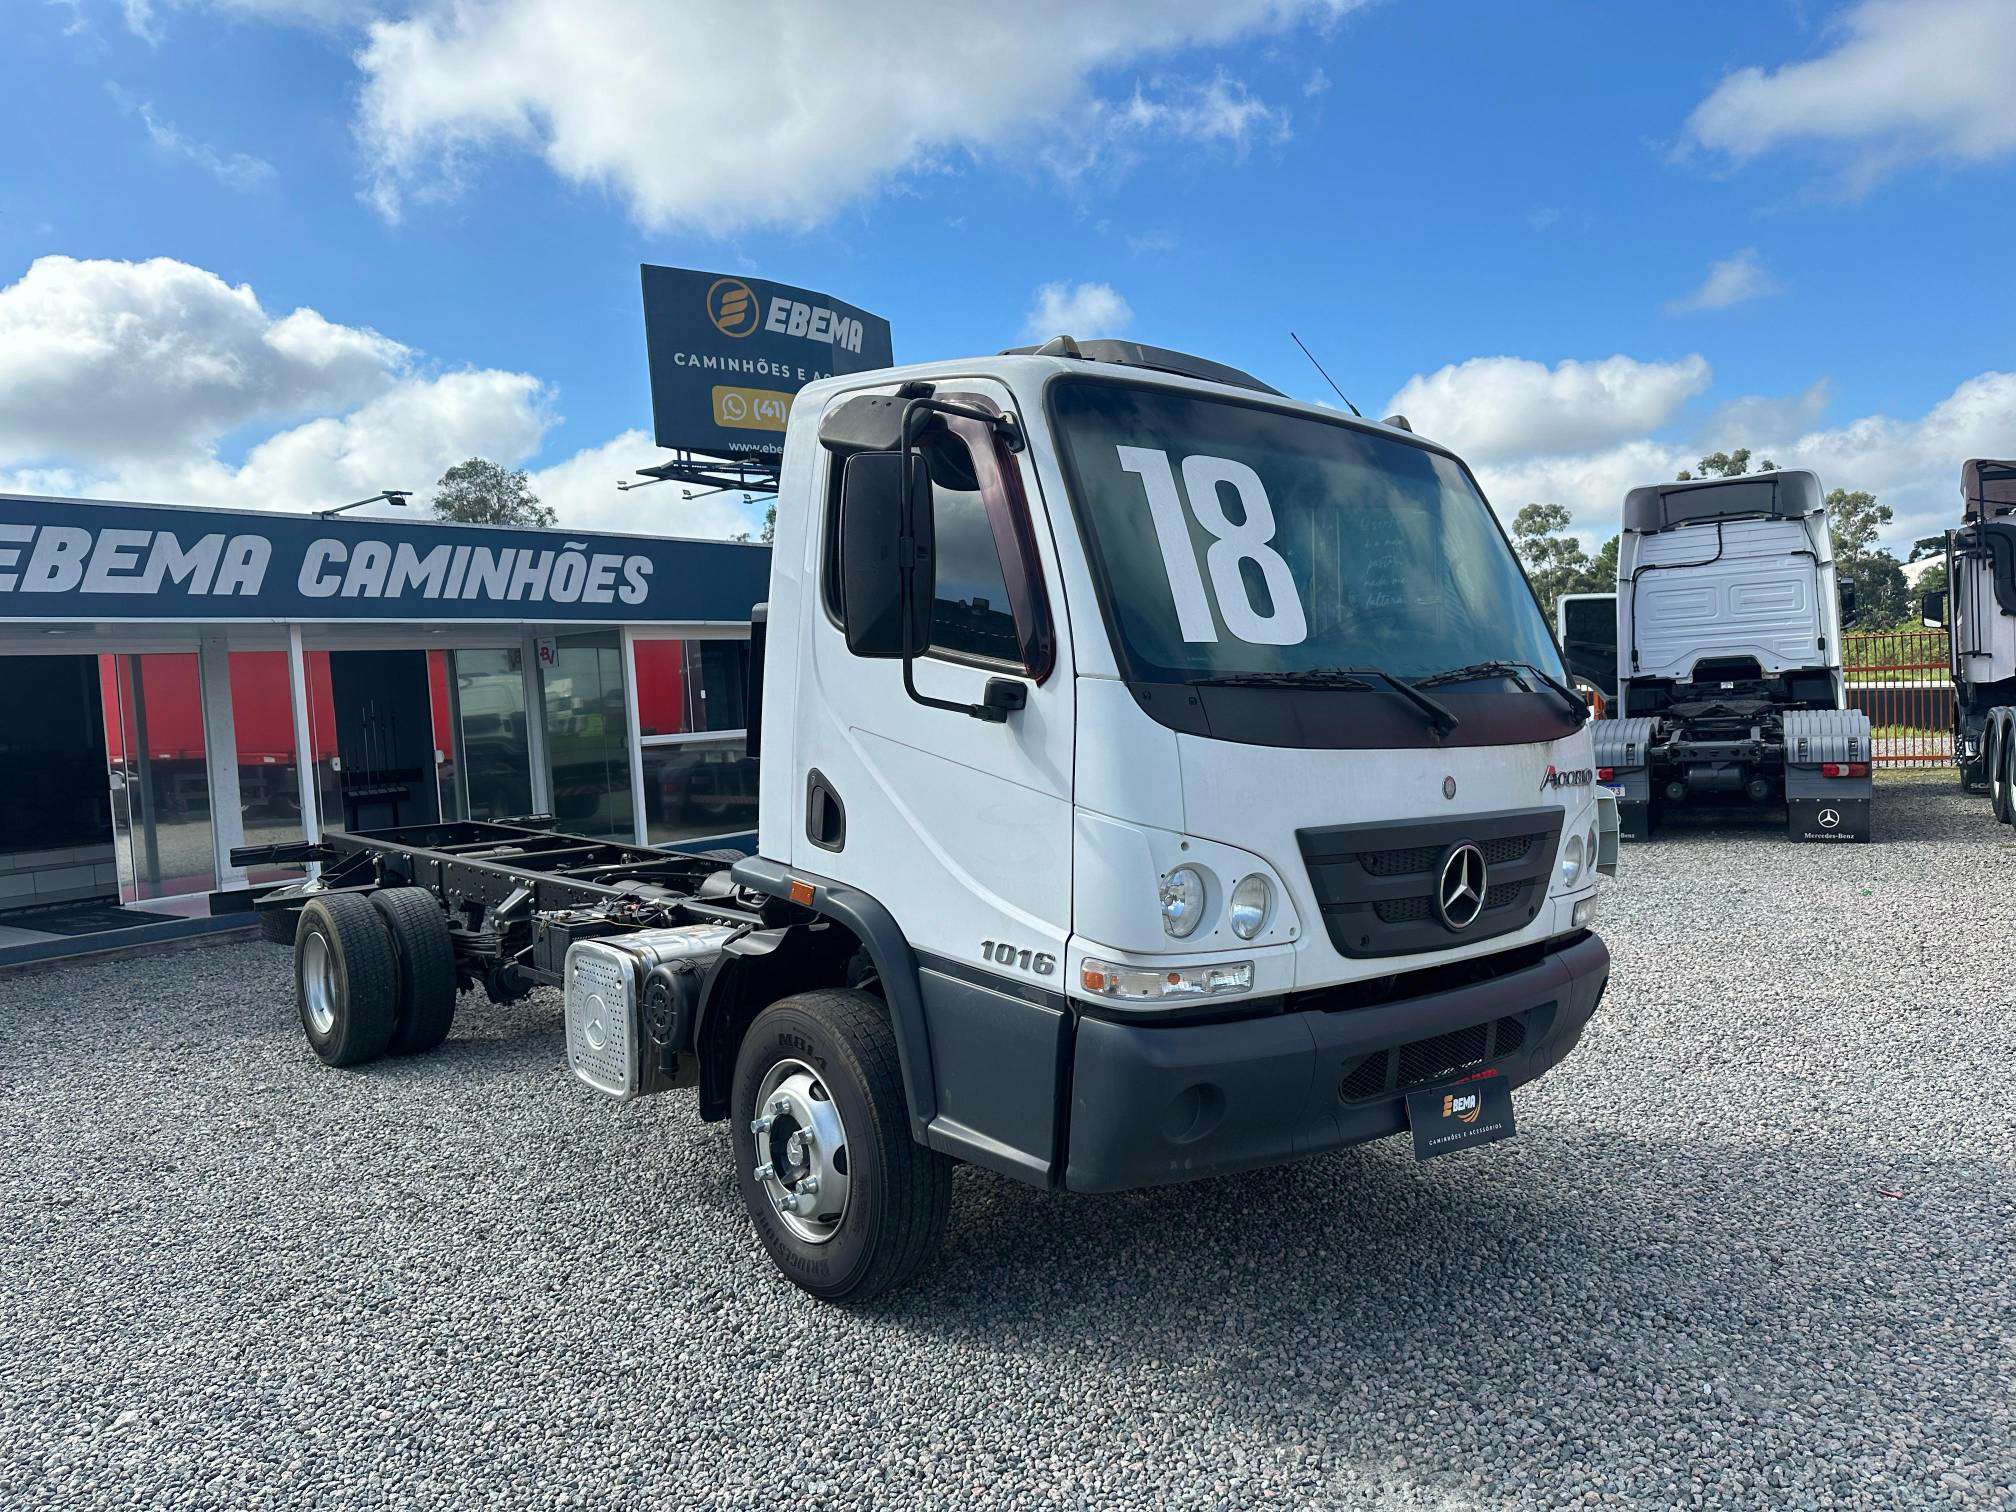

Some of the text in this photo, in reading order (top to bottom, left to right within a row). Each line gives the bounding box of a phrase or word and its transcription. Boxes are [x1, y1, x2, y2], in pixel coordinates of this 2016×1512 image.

[765, 297, 864, 354] EBEMA
[674, 352, 790, 378] CAMINHÕES
[798, 368, 806, 381] E
[753, 399, 786, 423] (41)
[1116, 445, 1308, 645] 18
[297, 537, 654, 605] CAMINHÕES
[1804, 832, 1855, 840] Mercedes-Benz
[981, 940, 1056, 976] 1016
